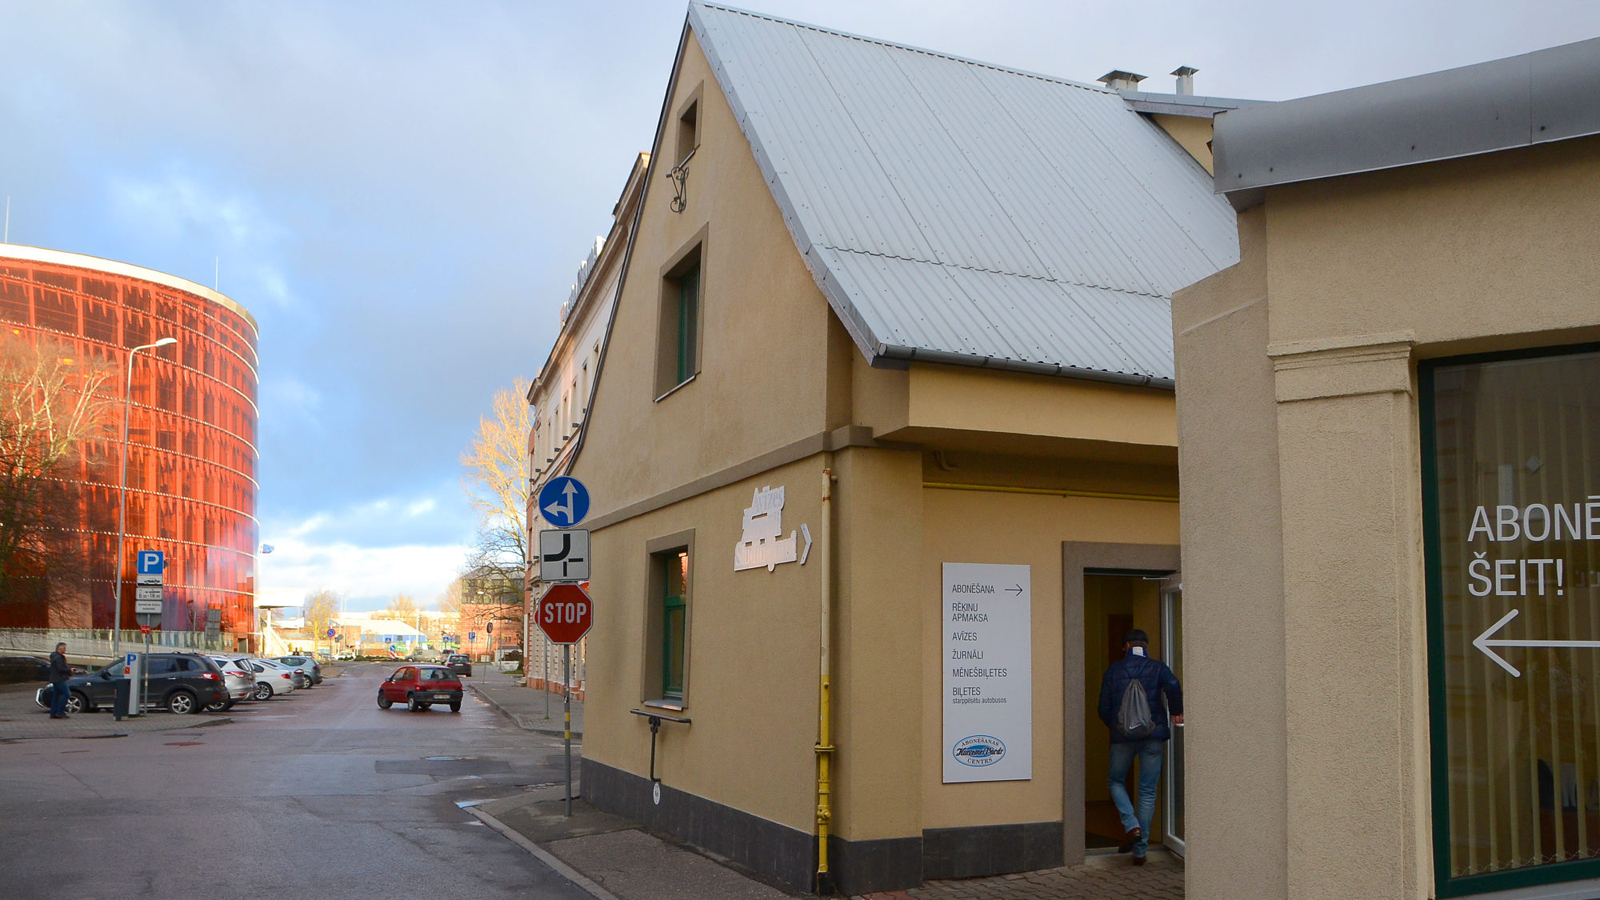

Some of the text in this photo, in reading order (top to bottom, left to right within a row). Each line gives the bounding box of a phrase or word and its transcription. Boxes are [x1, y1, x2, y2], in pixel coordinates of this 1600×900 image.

[144, 552, 159, 572] P
[1468, 551, 1563, 597] ŠEIT!
[952, 583, 995, 594] ABONĒŠANA
[544, 602, 587, 624] STOP
[952, 613, 988, 622] APMAKSA
[952, 631, 978, 641] AVĪZES
[127, 654, 136, 665] P
[952, 649, 984, 660] ŽURNĀLI
[952, 667, 1008, 679] MĒNEŠBIĻETES
[952, 687, 981, 697] BIĻETES
[961, 737, 999, 747] ABONĒŠANAS
[966, 757, 993, 765] CENTRS
